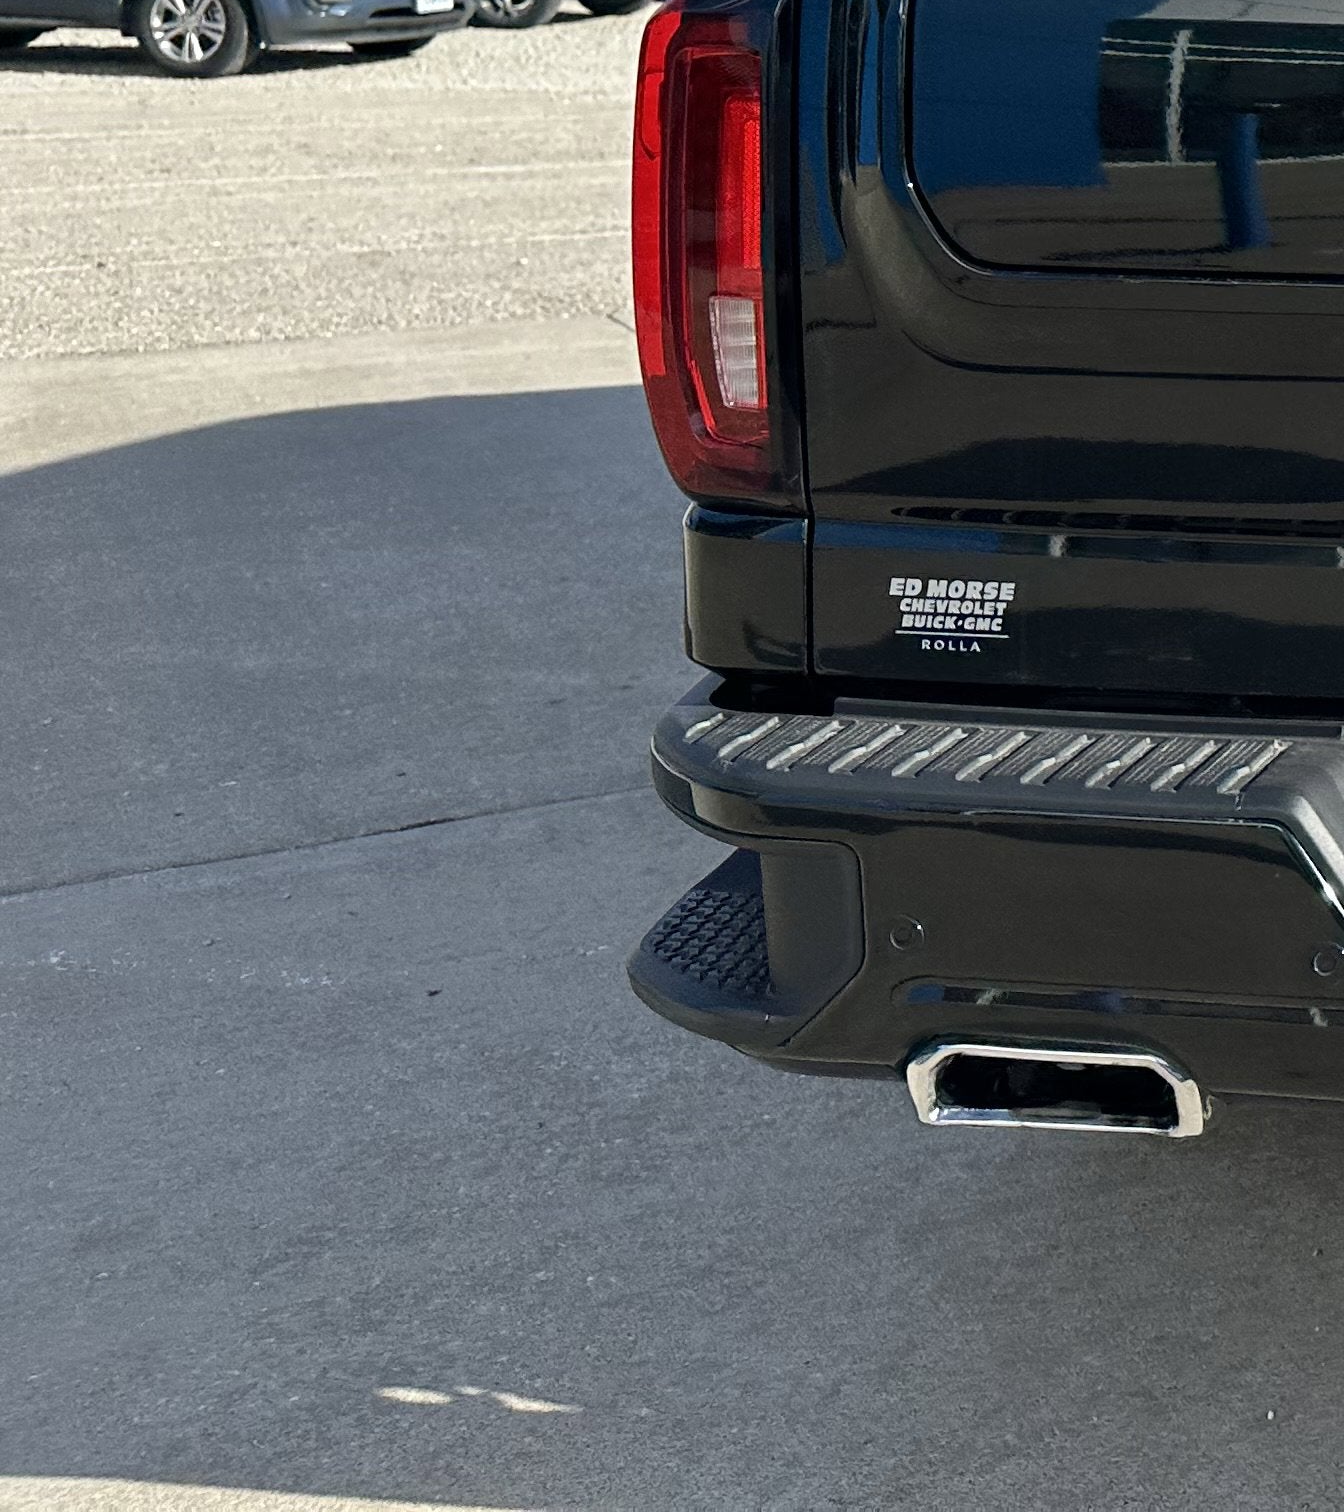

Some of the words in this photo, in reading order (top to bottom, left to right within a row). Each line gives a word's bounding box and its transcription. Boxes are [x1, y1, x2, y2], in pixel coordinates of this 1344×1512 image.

[889, 577, 923, 596] ED
[926, 578, 1016, 601] MORSE
[899, 598, 1007, 616] CHEVROLET
[921, 639, 981, 653] ROLLA
